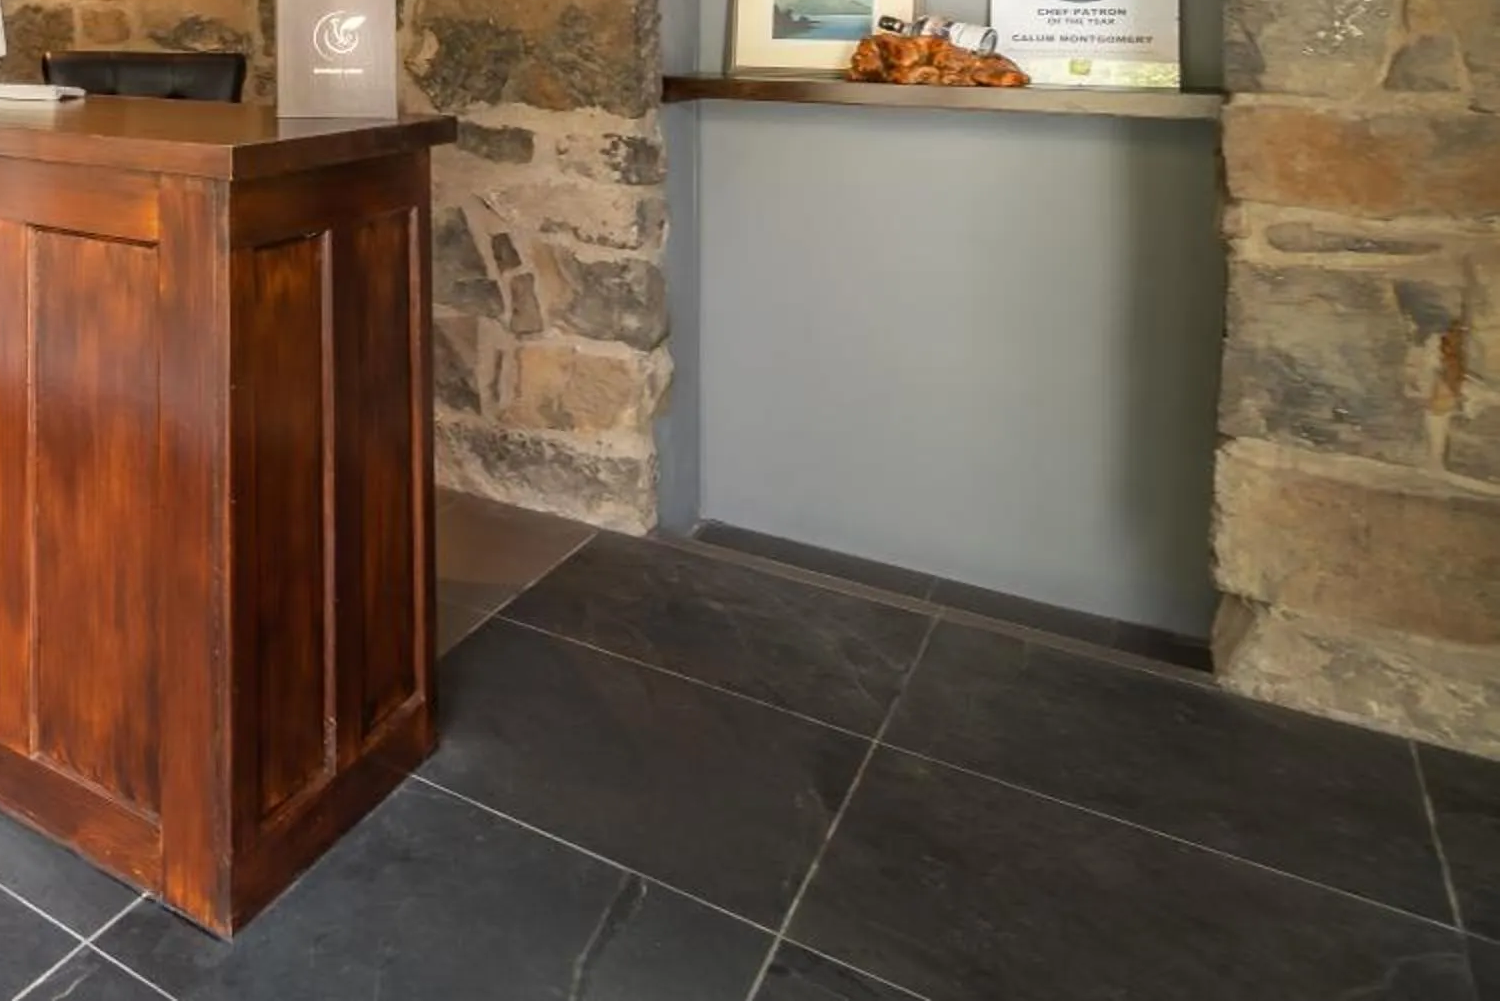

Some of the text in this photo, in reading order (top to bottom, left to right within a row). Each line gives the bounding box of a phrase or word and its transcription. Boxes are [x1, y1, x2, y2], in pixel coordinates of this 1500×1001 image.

[1037, 8, 1127, 16] CHEF PATRON
[1059, 35, 1154, 44] MONTGOMERY
